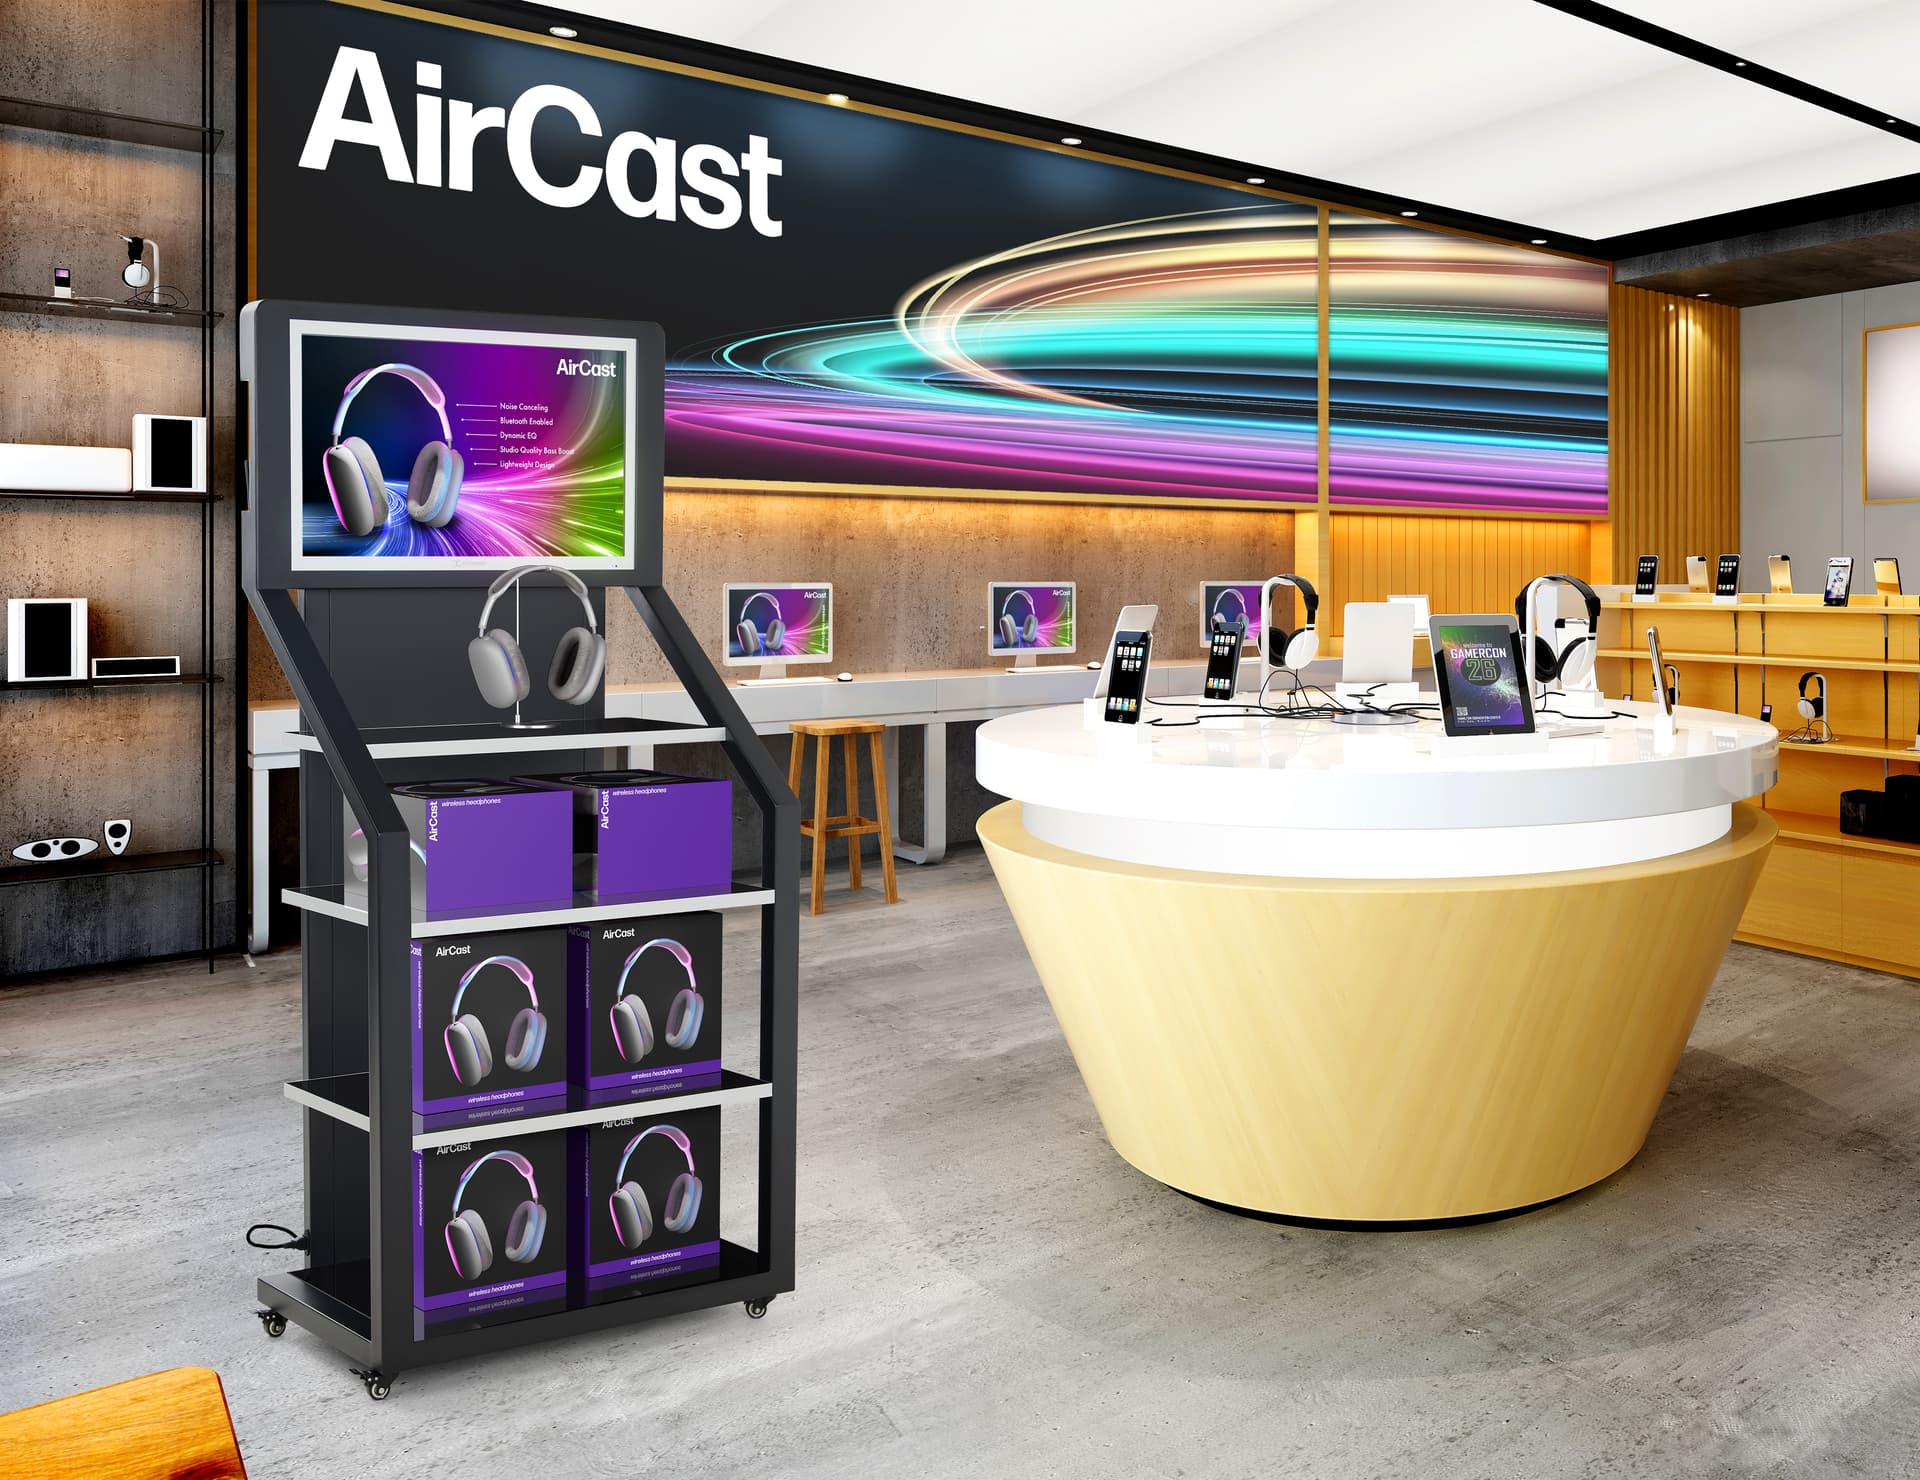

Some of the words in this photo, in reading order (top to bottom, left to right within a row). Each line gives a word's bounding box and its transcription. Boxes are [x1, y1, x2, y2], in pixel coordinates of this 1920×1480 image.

[298, 45, 783, 238] AirCast
[556, 358, 617, 378] AirCast
[500, 402, 518, 411] Noise
[519, 403, 549, 413] Canceling
[500, 417, 528, 425] Bluetooth
[529, 417, 554, 426] Enabled
[500, 432, 526, 441] Dynamic
[527, 432, 538, 441] EQ
[500, 446, 519, 454] Studio
[520, 447, 542, 456] Quality
[543, 447, 557, 455] Bass
[558, 448, 575, 456] Boost
[500, 461, 534, 470] Lightweight
[535, 461, 555, 471] Design
[804, 591, 827, 600] AirCast
[1451, 647, 1507, 659] GAMERCON
[1466, 658, 1497, 681] 26
[634, 787, 667, 795] headphones
[465, 798, 502, 806] headphones
[600, 790, 610, 829] AirCast
[428, 800, 438, 842] AirCast
[602, 927, 636, 940] AirCast
[435, 944, 472, 957] AirCast
[631, 1072, 652, 1080] wireless
[652, 1068, 683, 1077] headphones
[467, 1095, 491, 1104] wireless
[490, 1090, 525, 1100] headphones
[436, 1143, 472, 1155] AirCast
[650, 1251, 682, 1262] headphones
[490, 1282, 525, 1293] headphones
